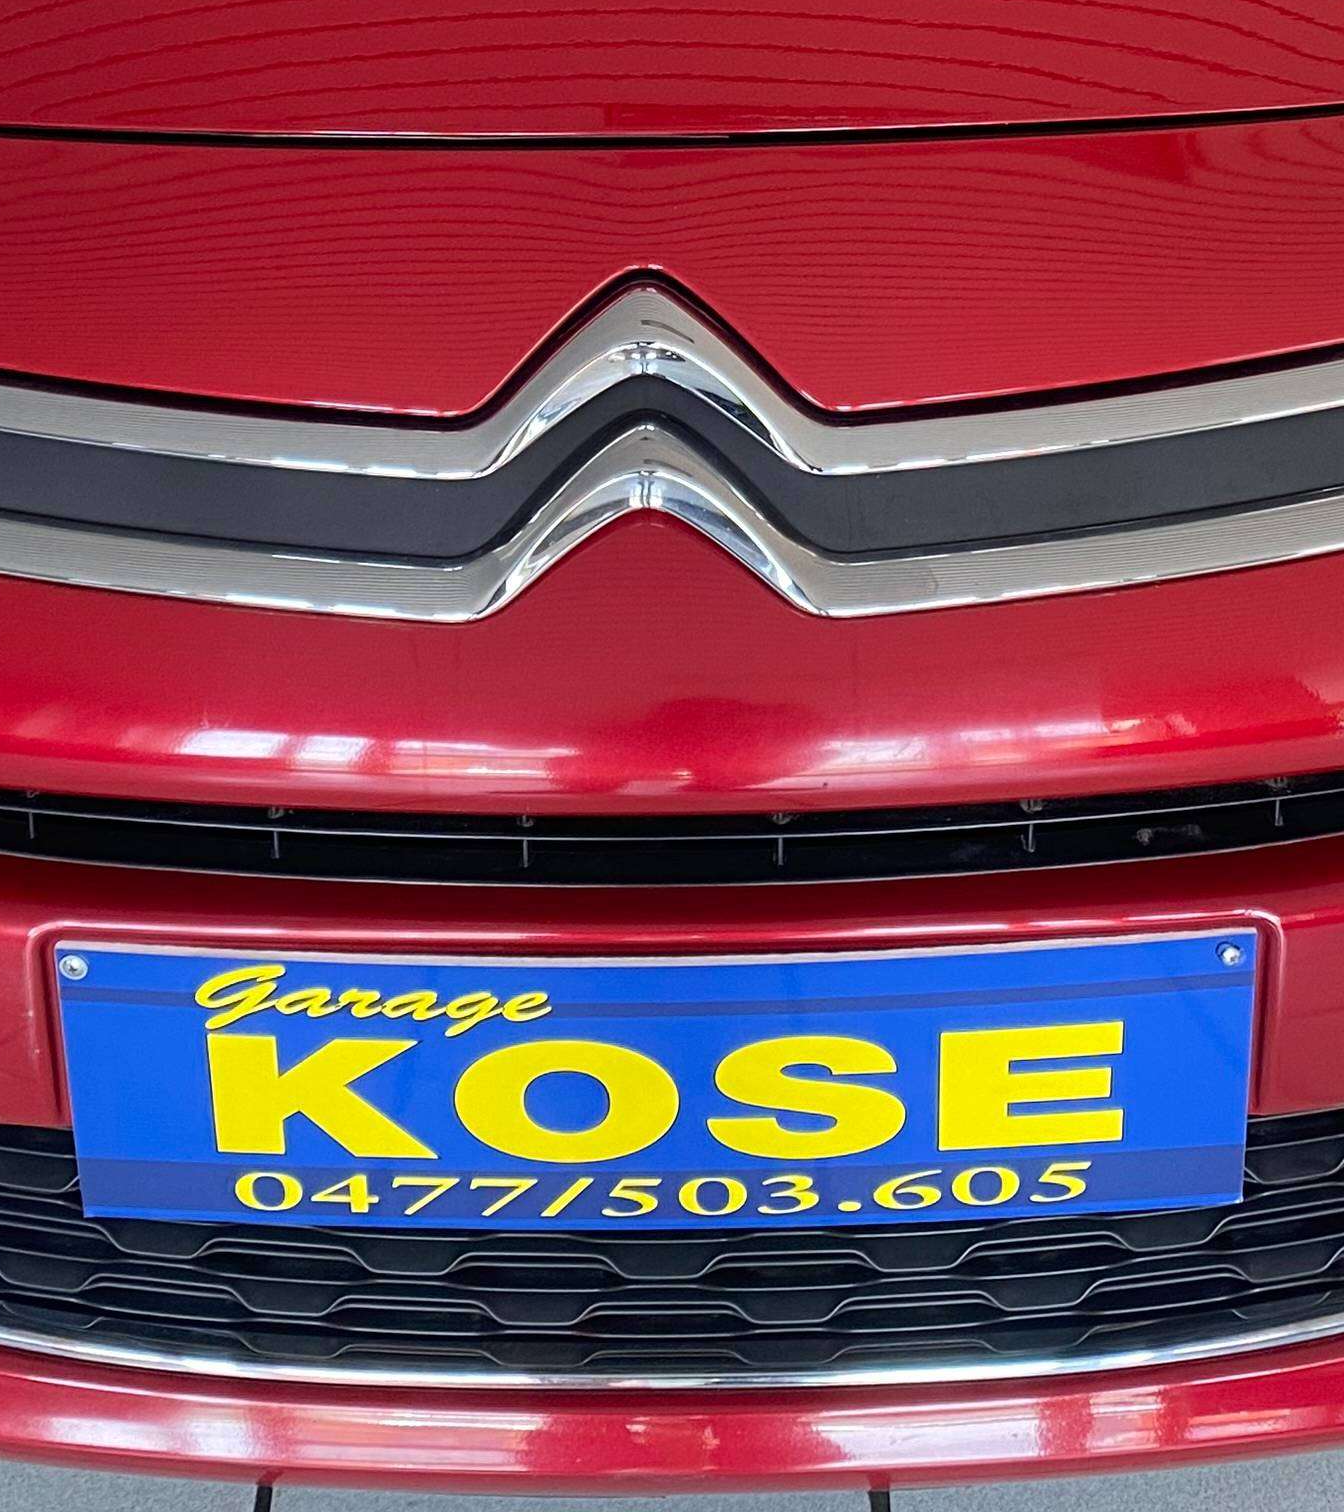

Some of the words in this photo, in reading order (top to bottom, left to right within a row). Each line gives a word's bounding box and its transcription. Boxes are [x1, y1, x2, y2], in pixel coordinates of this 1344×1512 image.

[195, 963, 551, 1035] Garage
[207, 1020, 1124, 1163] KOSE
[233, 1162, 1091, 1216] 0477/503.605
